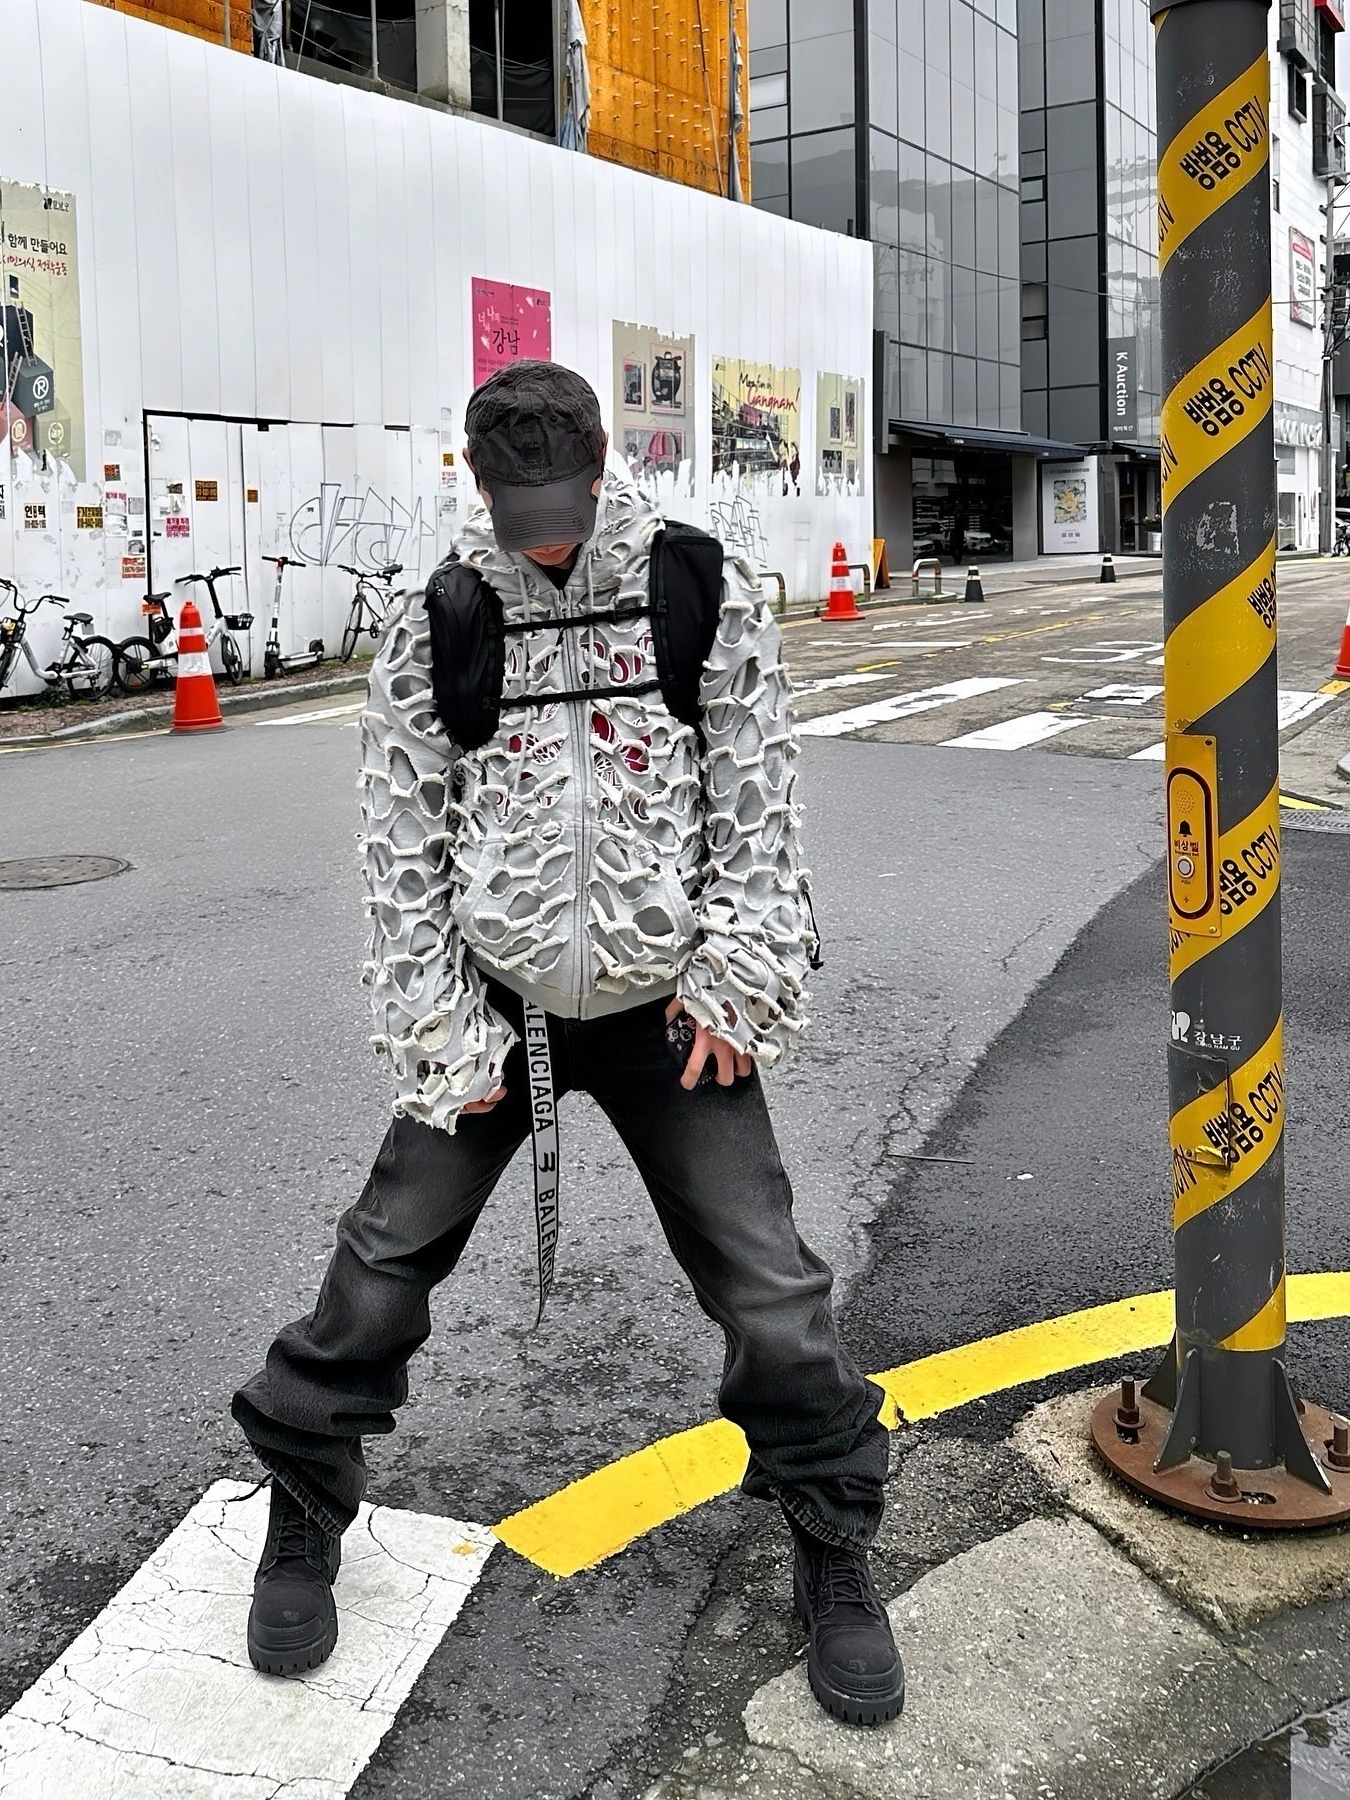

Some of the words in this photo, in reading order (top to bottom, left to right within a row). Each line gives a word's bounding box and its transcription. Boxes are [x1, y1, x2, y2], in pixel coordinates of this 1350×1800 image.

[1179, 131, 1241, 190] 방범용
[1224, 95, 1268, 152] CCTV
[7, 233, 27, 250] 함께
[30, 238, 67, 255] 만들어요
[492, 327, 520, 355] 강남
[1116, 352, 1128, 361] K
[1116, 364, 1129, 416] Auction
[1183, 378, 1245, 436] 방범용
[1228, 342, 1271, 399] CCTV
[1174, 840, 1199, 852] 비상벨
[1220, 859, 1257, 915] 범용
[1241, 824, 1280, 879] CCTV
[1194, 1030, 1242, 1047] 강남구
[1248, 1062, 1284, 1124] CCTV
